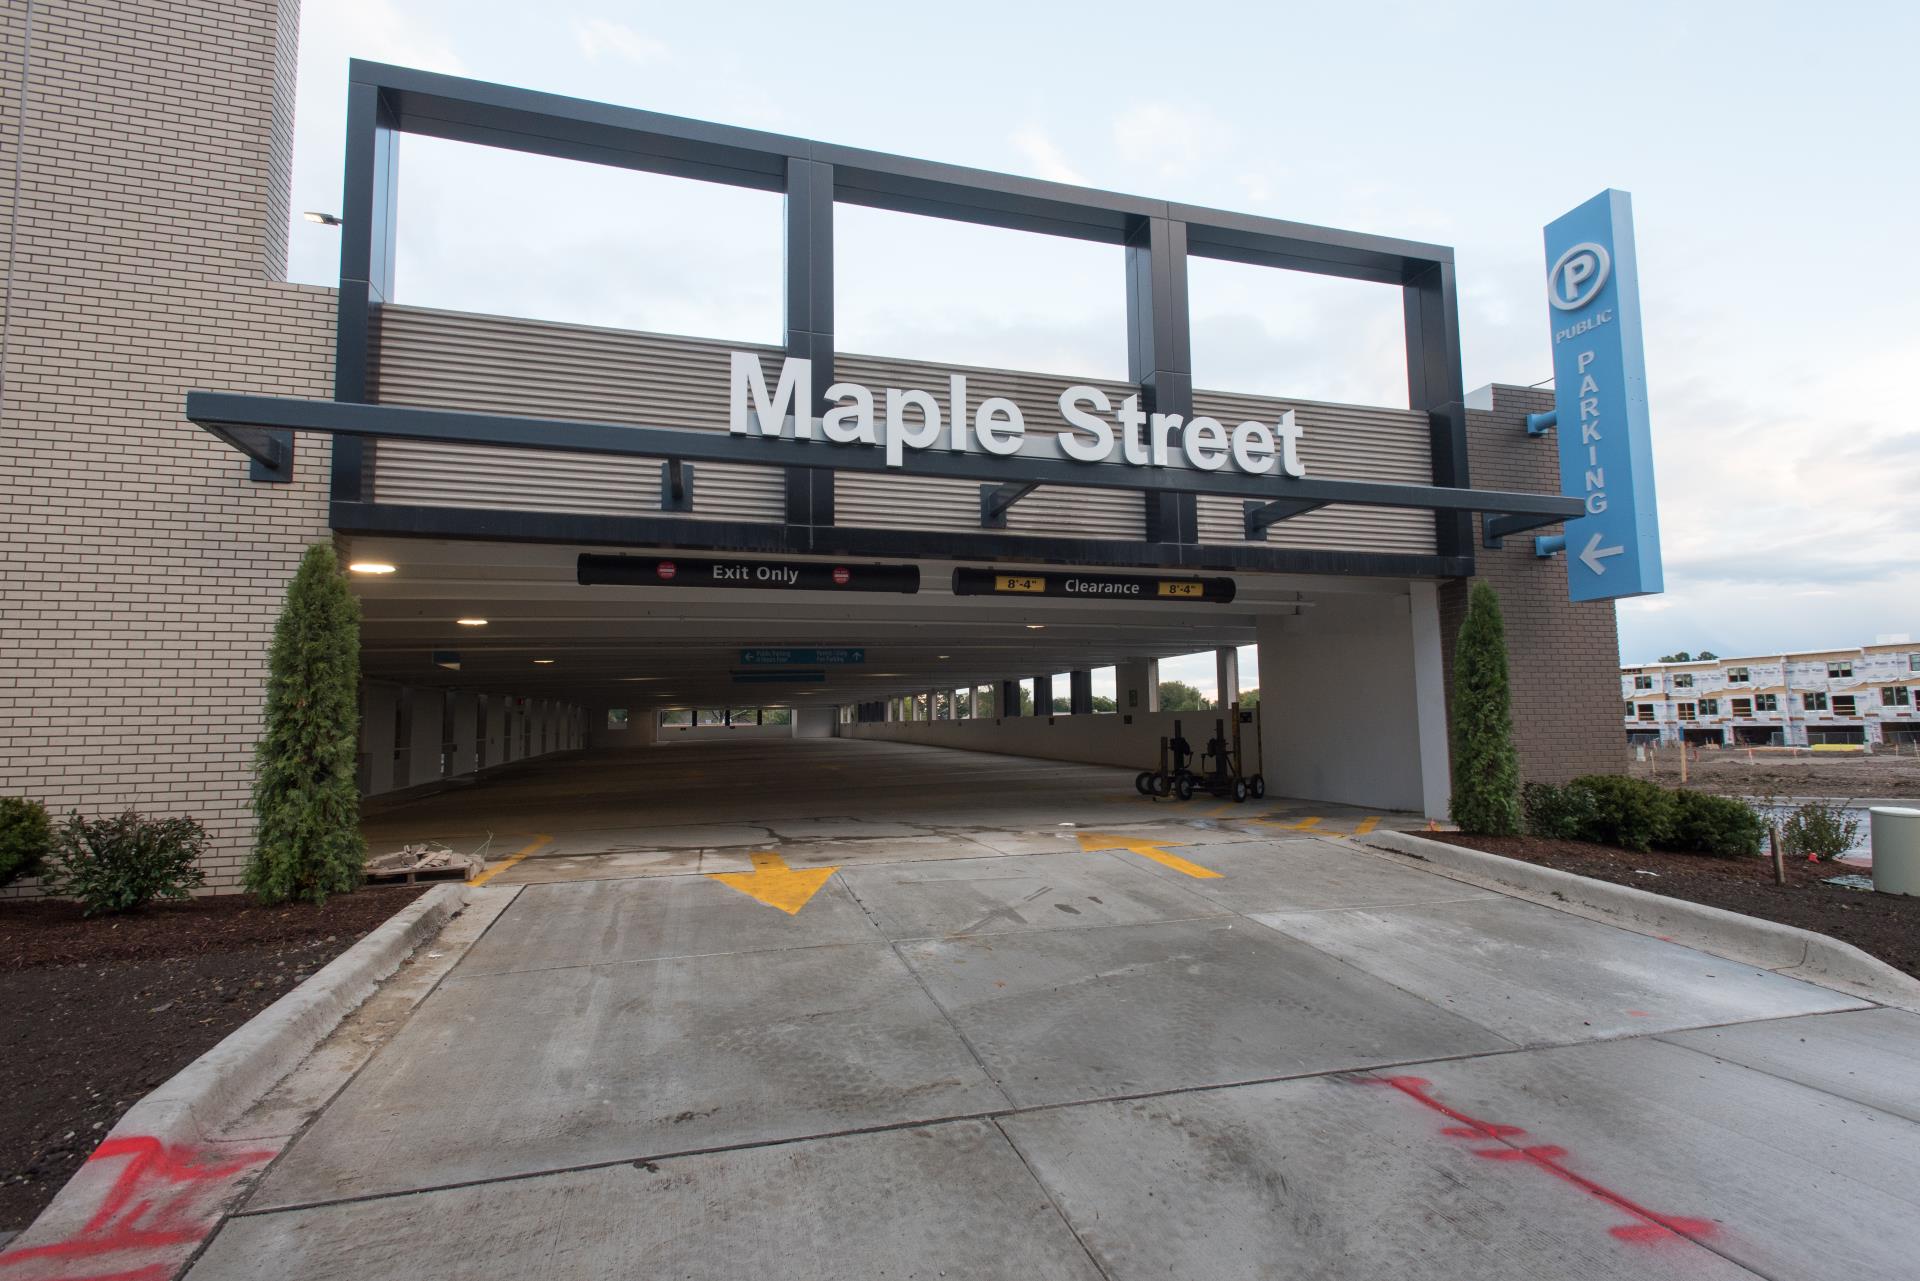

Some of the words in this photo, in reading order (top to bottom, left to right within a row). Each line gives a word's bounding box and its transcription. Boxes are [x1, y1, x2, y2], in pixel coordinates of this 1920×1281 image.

[1564, 254, 1595, 300] P
[1556, 309, 1612, 344] PUBLIC
[729, 351, 1025, 467] Maple
[1058, 384, 1306, 478] Street
[1578, 350, 1608, 515] PARKING
[712, 564, 749, 580] Exit
[756, 566, 799, 585] Only
[1064, 579, 1141, 594] Clearance
